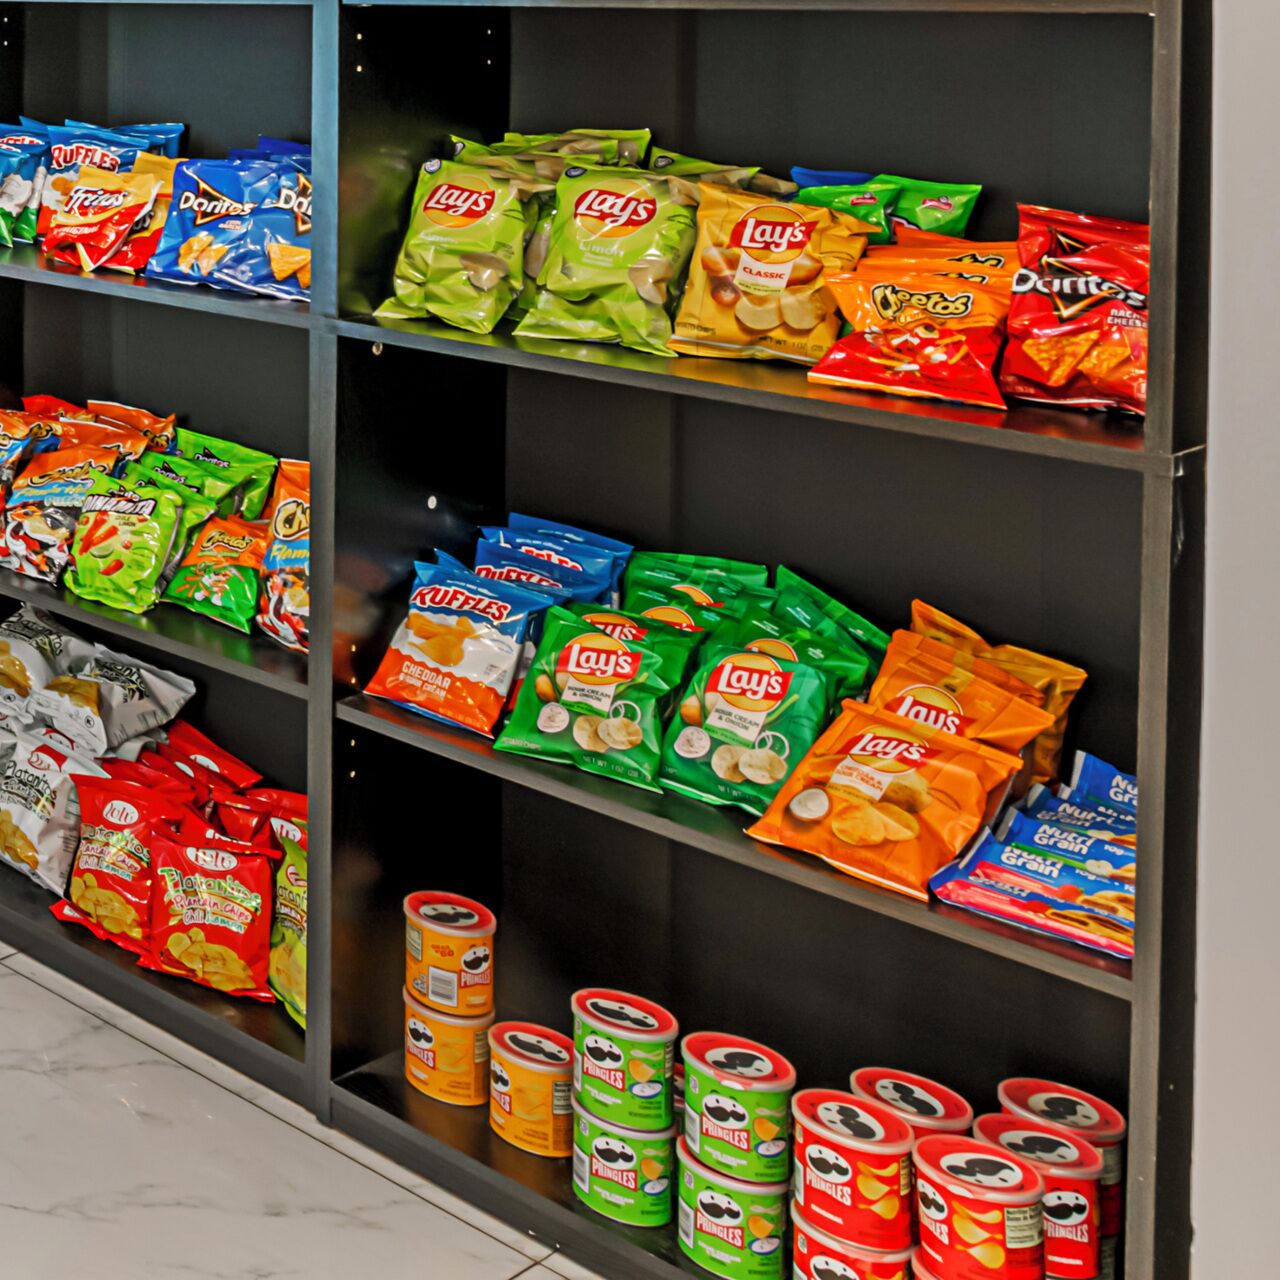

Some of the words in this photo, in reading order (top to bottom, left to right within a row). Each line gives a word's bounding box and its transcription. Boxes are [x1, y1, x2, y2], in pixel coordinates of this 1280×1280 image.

[51, 145, 119, 173] RUFFLES
[65, 186, 128, 214] Fritos
[179, 191, 256, 217] Doritos
[426, 184, 489, 214] Lay's
[575, 189, 654, 226] Lay's
[740, 216, 812, 254] Lay's
[742, 266, 786, 280] CLASSIC
[872, 284, 973, 320] Cheetos
[1012, 267, 1147, 310] Doritos
[194, 453, 231, 468] Doritos
[82, 494, 157, 516] DINAMITA
[412, 585, 509, 621] RUFFLES
[402, 661, 451, 689] CHEDDAR
[568, 644, 631, 683] Lay's
[422, 683, 447, 700] CREAM
[587, 688, 611, 699] CREAM
[718, 663, 782, 700] Lay's
[734, 712, 760, 728] CREAM
[851, 732, 927, 760] Lay's
[1033, 833, 1089, 855] Grain
[1038, 824, 1096, 847] Nutri
[115, 853, 141, 872] Chips
[1001, 852, 1060, 879] Grain
[158, 867, 261, 910] Platanitos
[172, 893, 220, 913] Plantain
[222, 903, 252, 922] Chips
[183, 908, 206, 925] Chili
[206, 914, 244, 933] Lemon
[460, 969, 492, 988] PRINGLES
[583, 1059, 625, 1091] PRINGLES
[702, 1116, 750, 1151] PRINGLES
[592, 1159, 637, 1191] PRINGLES
[806, 1171, 852, 1206] PRINGLES
[696, 1210, 744, 1249] PRINGLES
